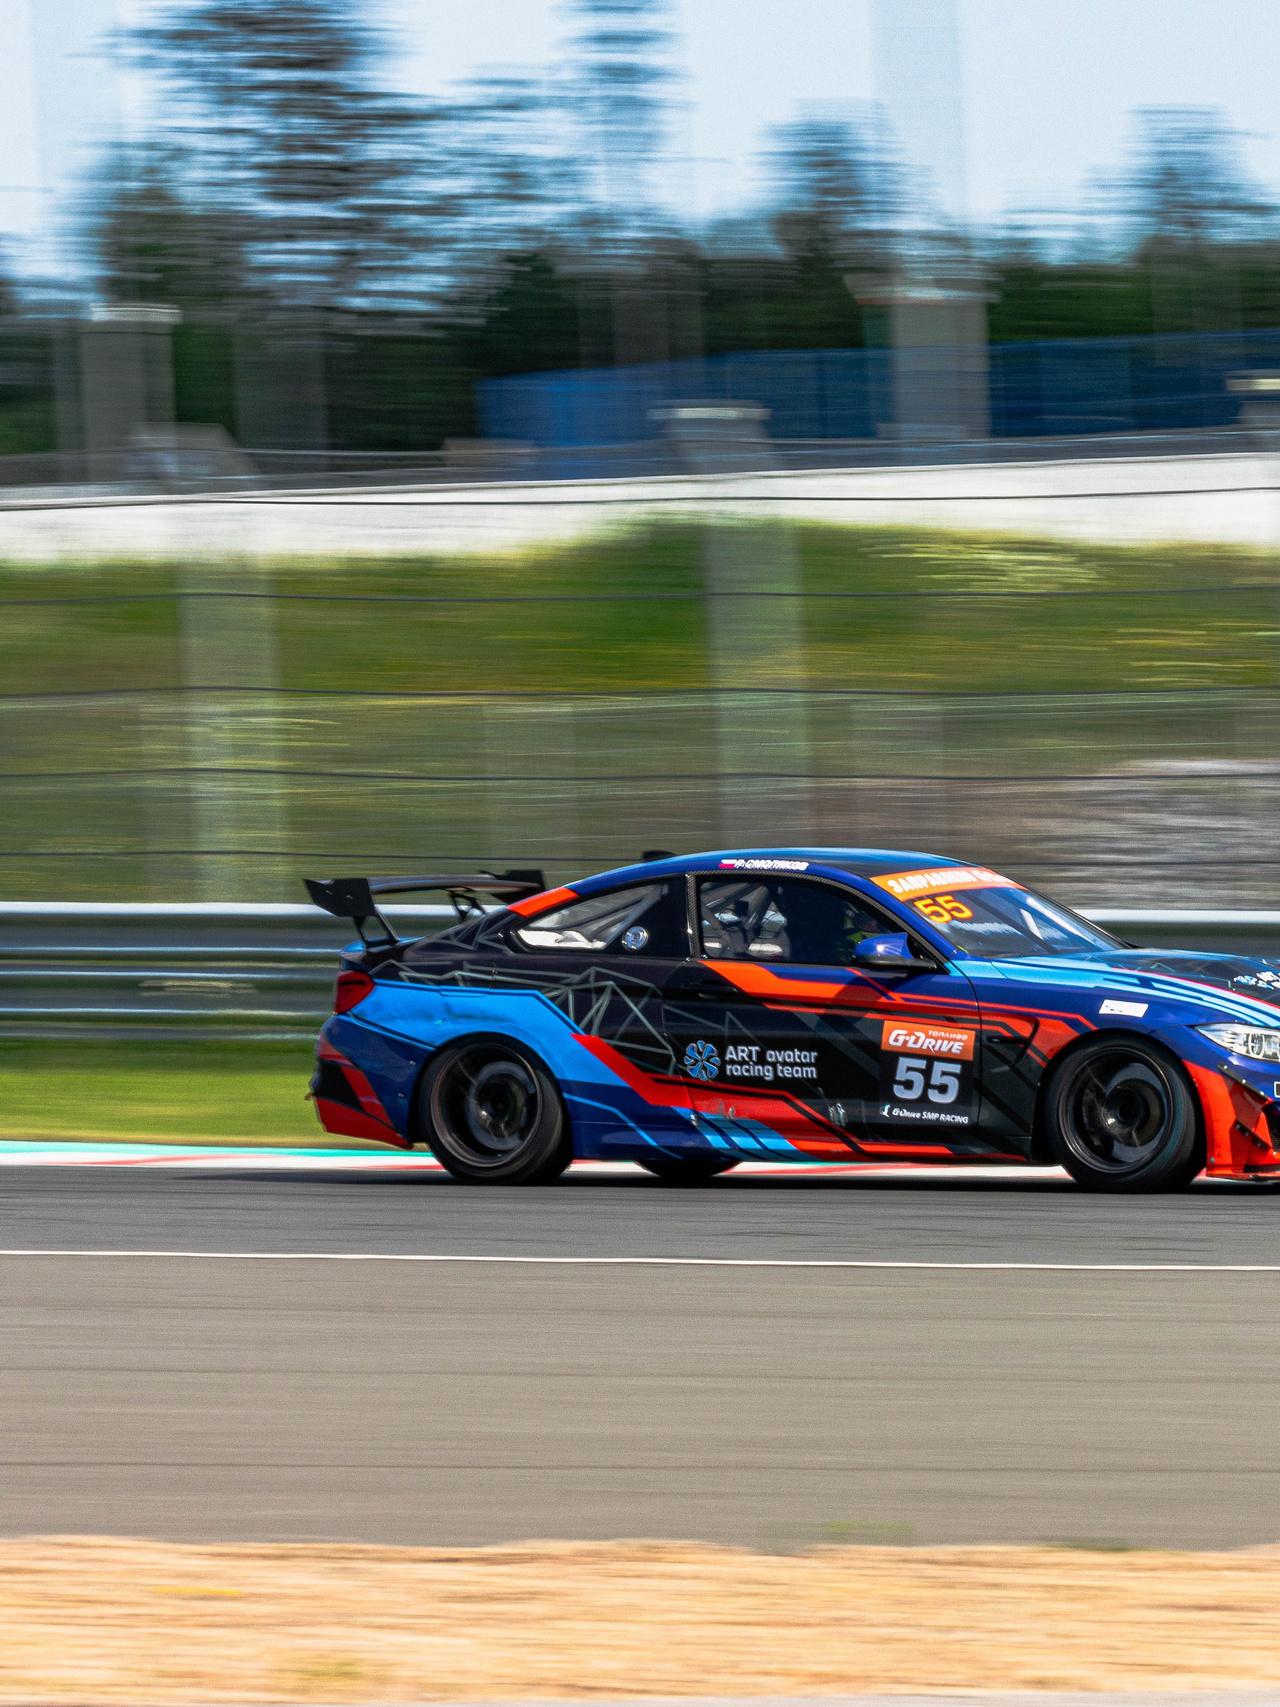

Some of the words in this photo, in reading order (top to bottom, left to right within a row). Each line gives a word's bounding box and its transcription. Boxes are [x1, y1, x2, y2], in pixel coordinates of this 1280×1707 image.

[913, 895, 973, 923] 55
[725, 1045, 761, 1061] ART
[766, 1048, 818, 1063] avatar
[726, 1061, 774, 1081] racing
[776, 1063, 817, 1078] team
[893, 1057, 962, 1104] 55
[921, 1111, 939, 1121] SMP
[939, 1113, 969, 1124] RACING
